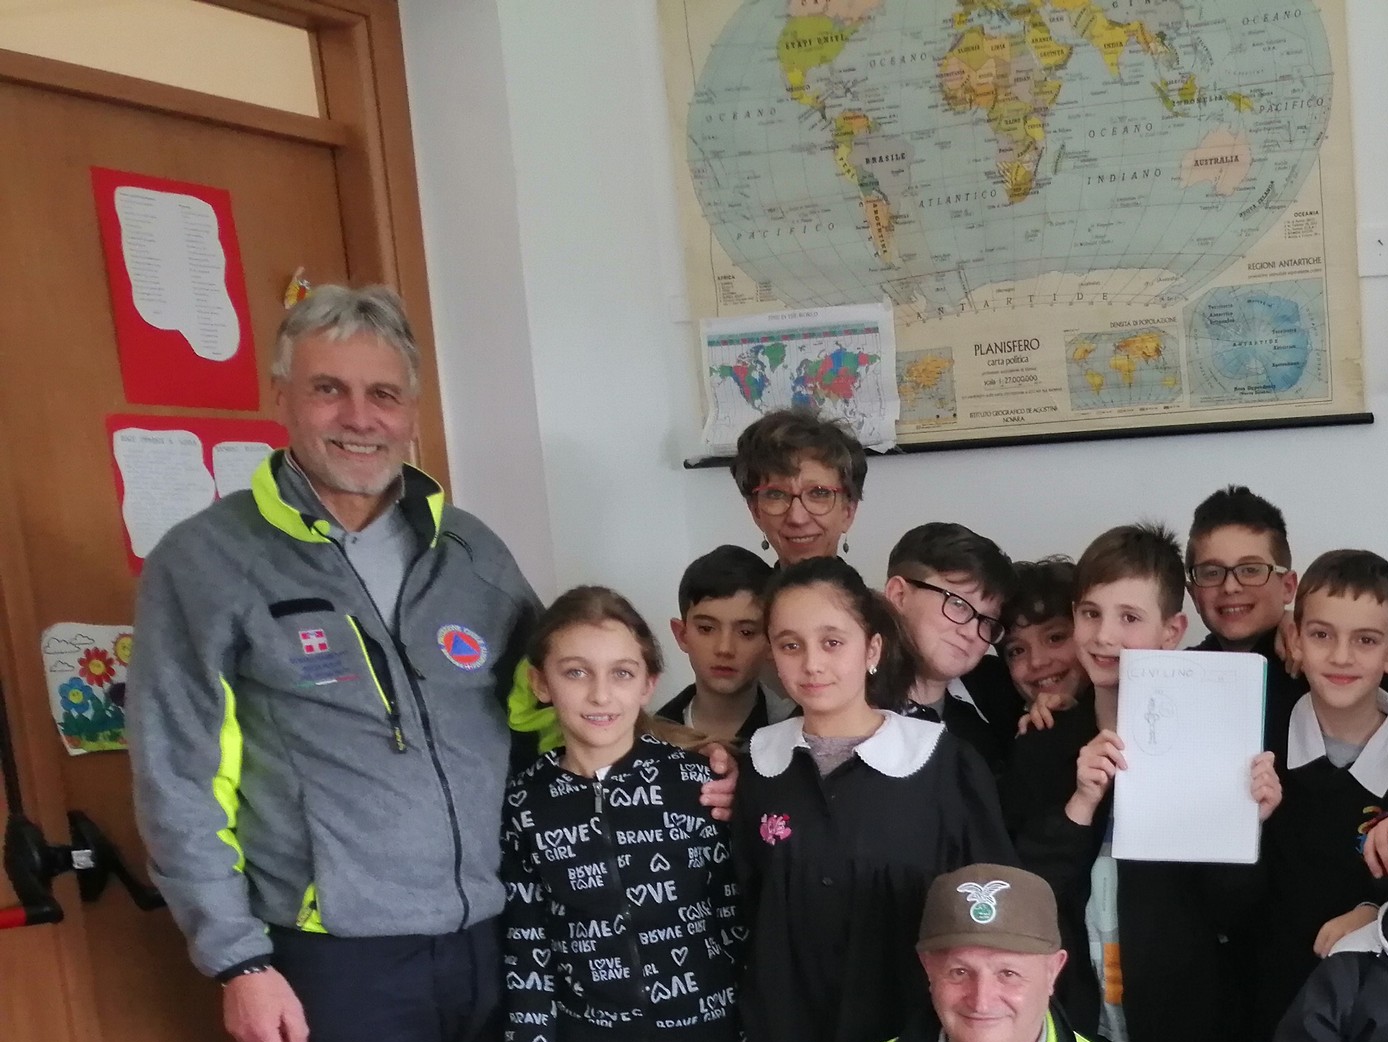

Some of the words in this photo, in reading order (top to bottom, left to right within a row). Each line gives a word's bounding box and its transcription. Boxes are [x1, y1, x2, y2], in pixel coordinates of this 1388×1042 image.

[1241, 9, 1302, 26] OCEANO
[869, 52, 927, 68] OCEANO
[1258, 98, 1324, 114] PACIFICO
[705, 107, 777, 123] OCEANO
[1088, 123, 1153, 138] OCEANO
[865, 152, 906, 165] BRASILE
[1193, 155, 1240, 167] AUSTRALIA
[1087, 168, 1162, 185] INDIANO
[918, 188, 997, 208] ATLANTICO
[1293, 209, 1320, 218] OCEANIA
[736, 222, 835, 241] PACIFICO
[1247, 261, 1276, 271] REGIONI
[1278, 257, 1322, 268] ANTARTICHE
[974, 338, 1040, 356] PLANISFERO
[987, 357, 1005, 367] carta
[1005, 355, 1029, 366] politica
[535, 823, 590, 850] LOVE
[616, 829, 664, 845] BRAVE
[545, 845, 577, 861] GIRL
[588, 957, 622, 971] LOVE
[592, 967, 631, 982] BRAVE
[699, 987, 736, 1014] LOVE
